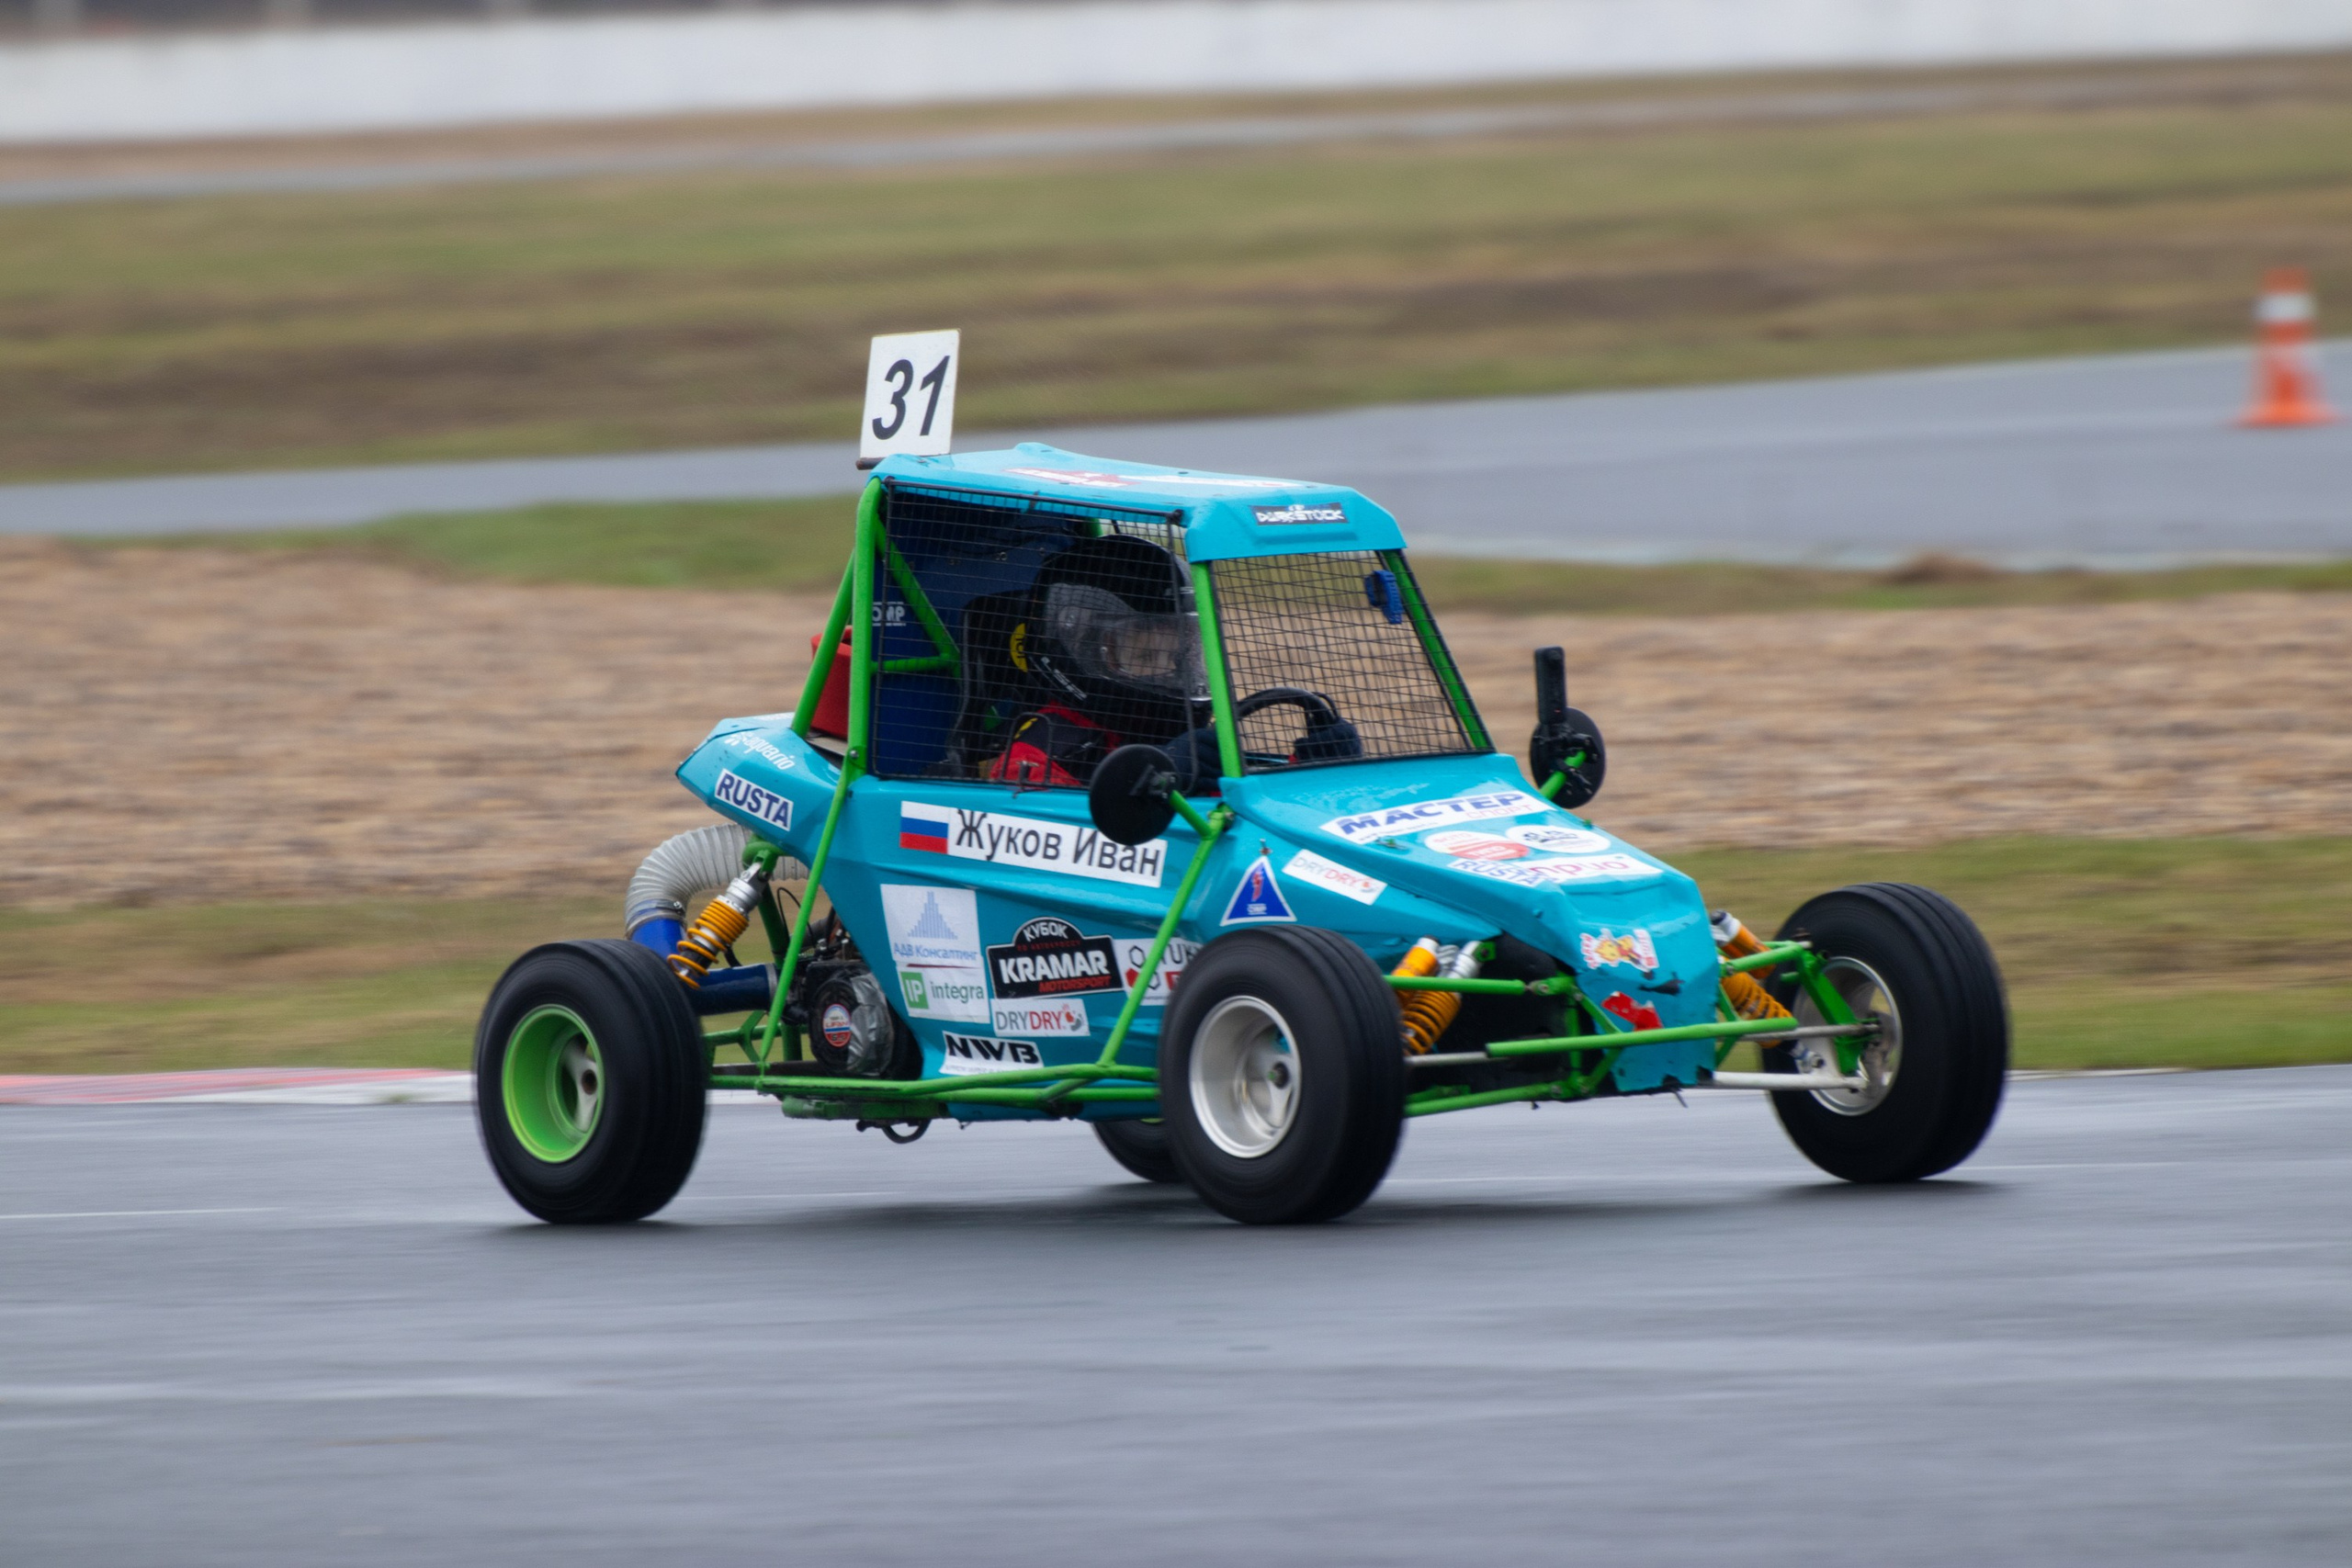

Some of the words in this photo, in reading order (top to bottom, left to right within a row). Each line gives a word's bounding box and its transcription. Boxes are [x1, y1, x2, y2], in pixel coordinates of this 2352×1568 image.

[872, 355, 951, 441] 31
[717, 773, 790, 828] RUSTA
[1336, 794, 1524, 835] МАСТЕР
[956, 808, 1063, 861] Жуков
[1073, 828, 1160, 876] Иван
[1293, 856, 1362, 888] DRYDRY
[1023, 921, 1069, 942] КУБОК
[999, 950, 1110, 985] KRAMAR
[905, 978, 924, 1003] IP
[930, 980, 985, 1004] integra
[1038, 976, 1112, 993] MOTORSPORT
[995, 1010, 1063, 1031] DRYDRY
[944, 1034, 1039, 1064] NWB
